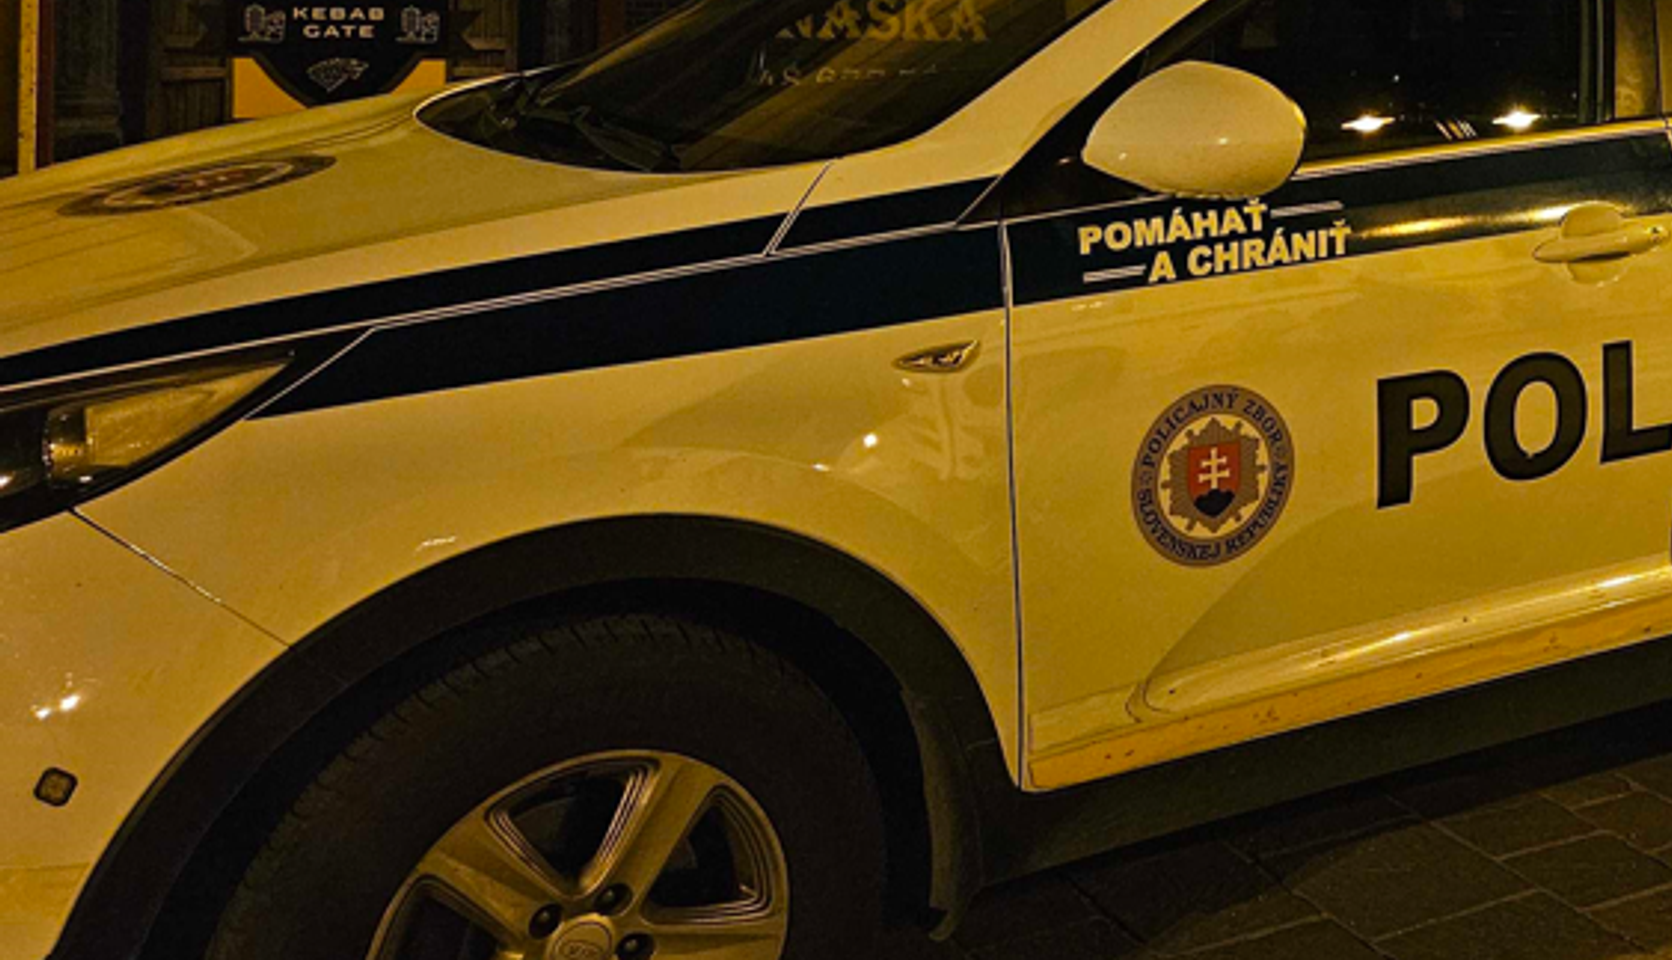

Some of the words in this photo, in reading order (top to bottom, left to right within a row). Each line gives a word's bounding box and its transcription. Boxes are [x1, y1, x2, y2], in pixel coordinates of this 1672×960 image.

[292, 6, 385, 21] KEBAB
[302, 23, 376, 39] GATE
[1078, 198, 1268, 255] POMÁHAŤ
[1148, 252, 1177, 283] A
[1188, 219, 1352, 278] CHRÁNIŤ
[1142, 388, 1239, 469] POLICAJNÝ
[1243, 398, 1286, 448] ZBOR
[1137, 488, 1222, 561] SLOVENSKEJ
[1225, 461, 1290, 556] REPUBLIKY
